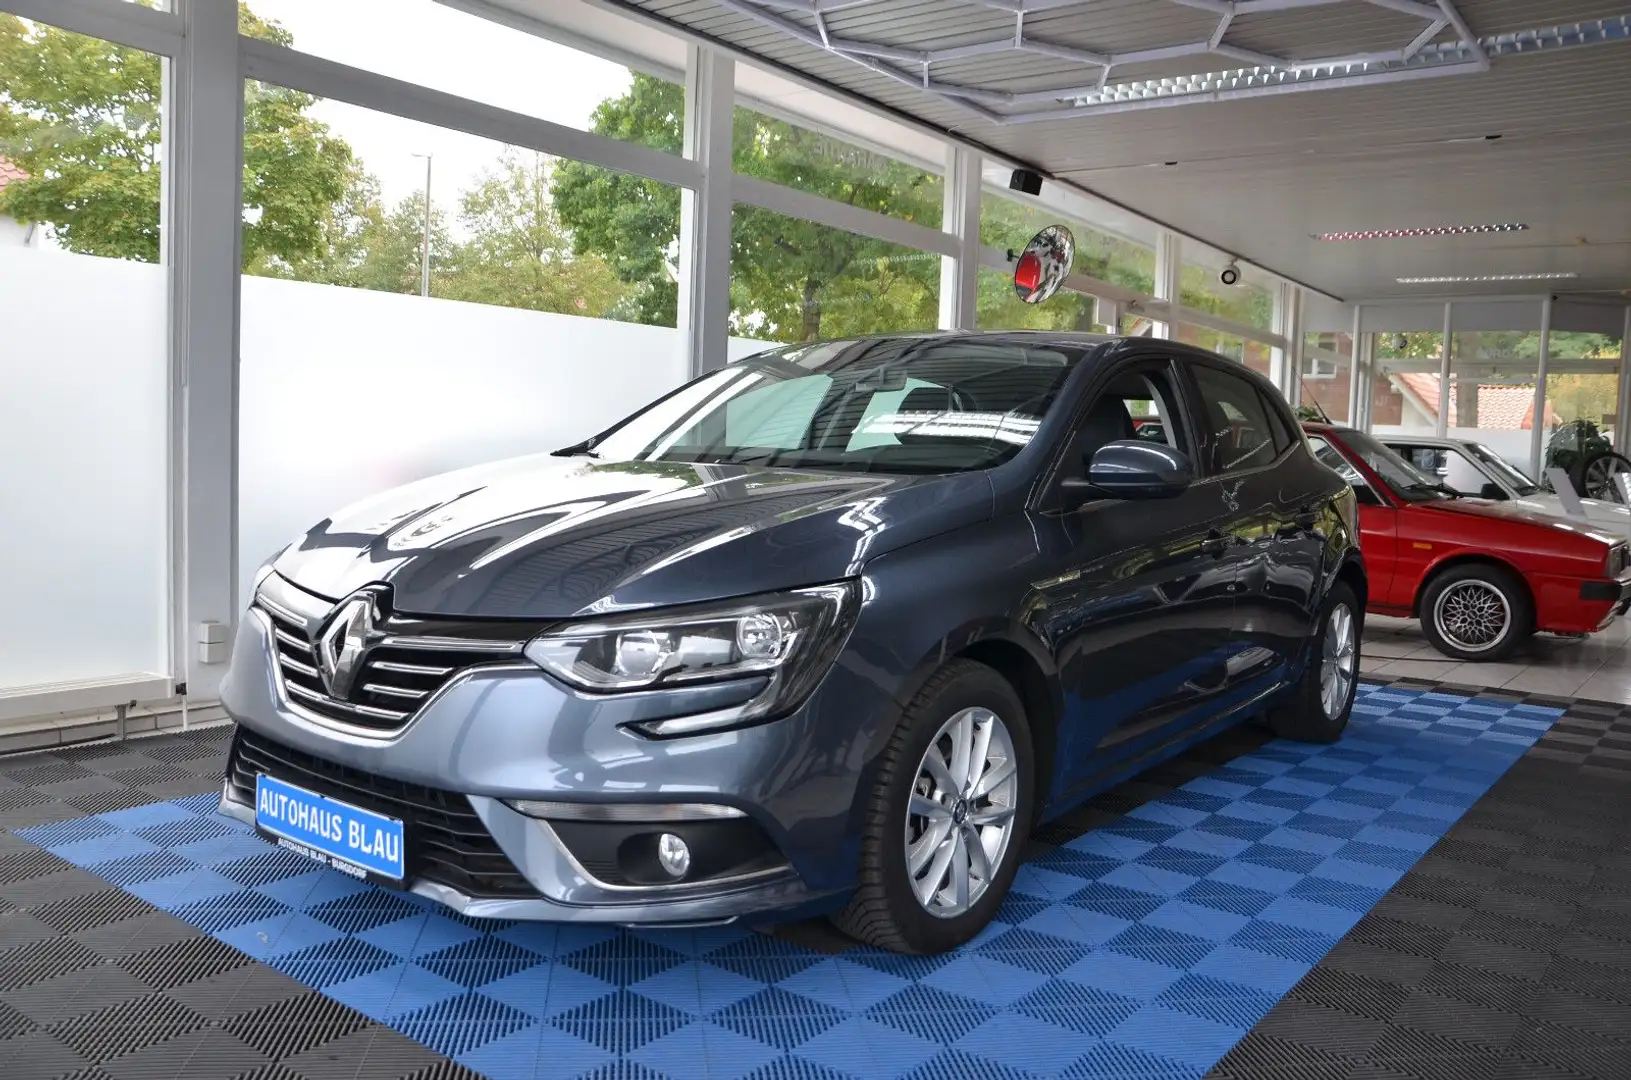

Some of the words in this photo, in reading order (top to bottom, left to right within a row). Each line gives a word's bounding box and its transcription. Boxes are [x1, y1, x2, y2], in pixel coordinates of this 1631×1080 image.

[260, 788, 342, 842] AUTOHAUS
[349, 820, 399, 863] BLAU
[278, 837, 309, 857] AUTOHAUS
[310, 850, 327, 863] BLAU
